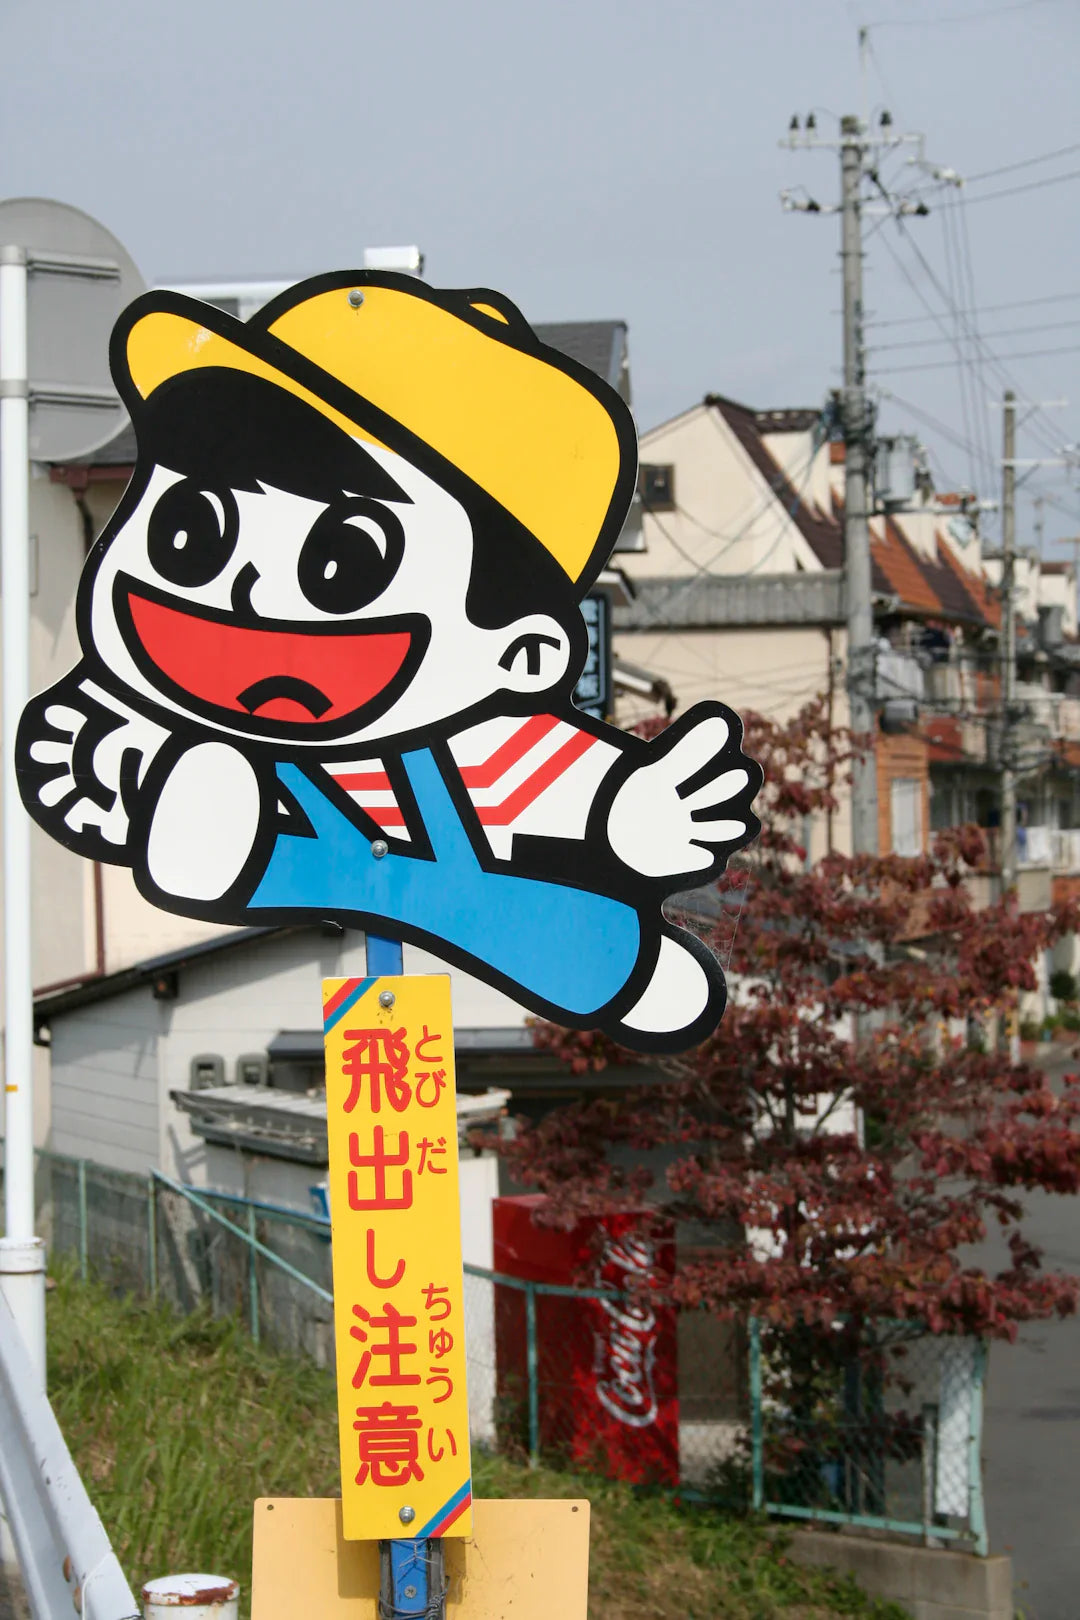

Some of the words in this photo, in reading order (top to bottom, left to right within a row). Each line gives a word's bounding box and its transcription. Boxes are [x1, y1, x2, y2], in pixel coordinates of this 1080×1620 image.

[342, 1026, 425, 1487] 飛出し注意
